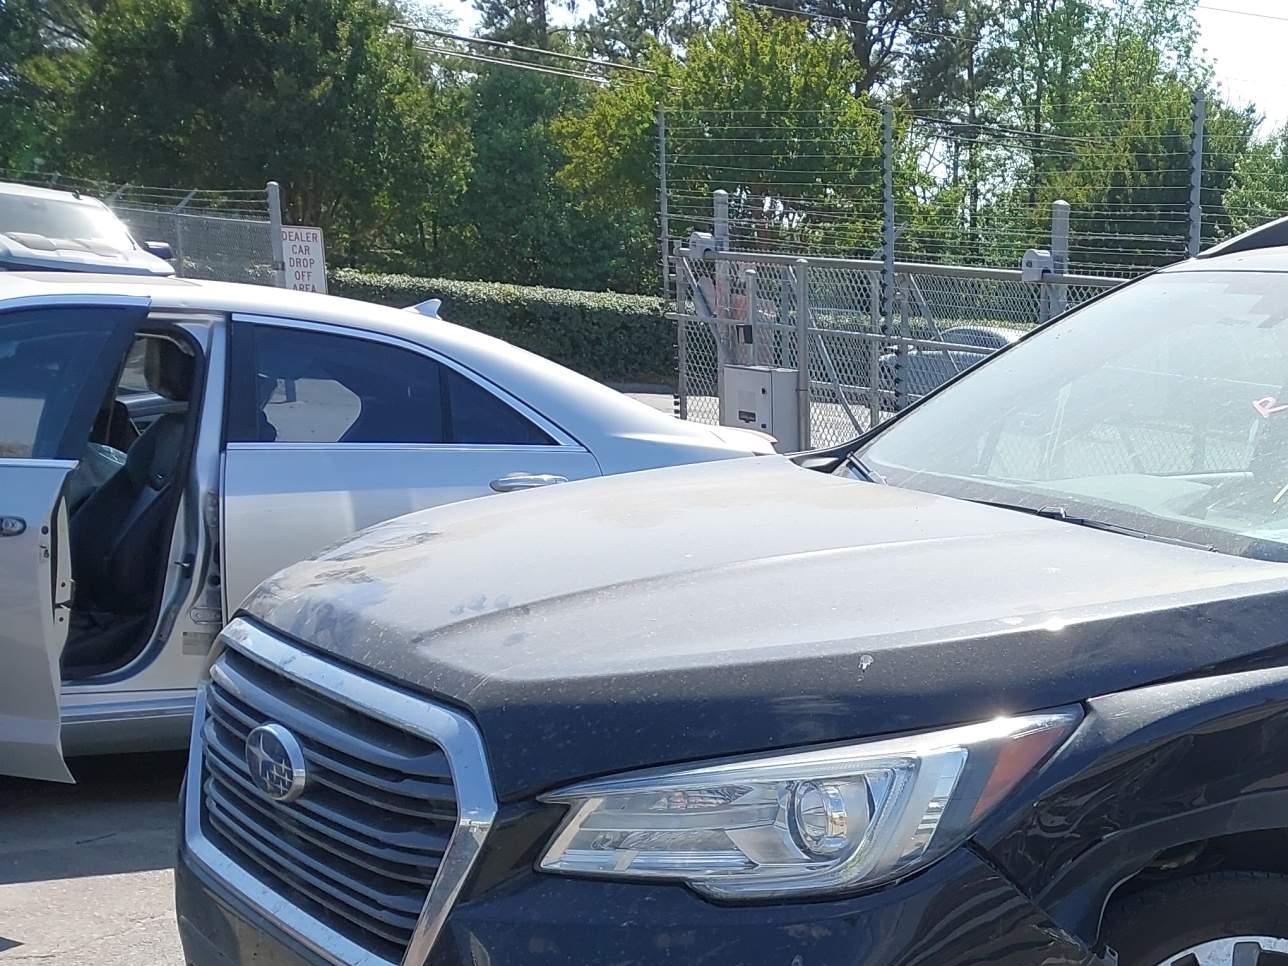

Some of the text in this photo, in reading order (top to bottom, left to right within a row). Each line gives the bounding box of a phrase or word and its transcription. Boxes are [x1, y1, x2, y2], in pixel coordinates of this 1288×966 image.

[282, 231, 318, 243] DEALER
[292, 245, 310, 255] CAR
[289, 257, 315, 268] DROP
[294, 270, 312, 281] OFF
